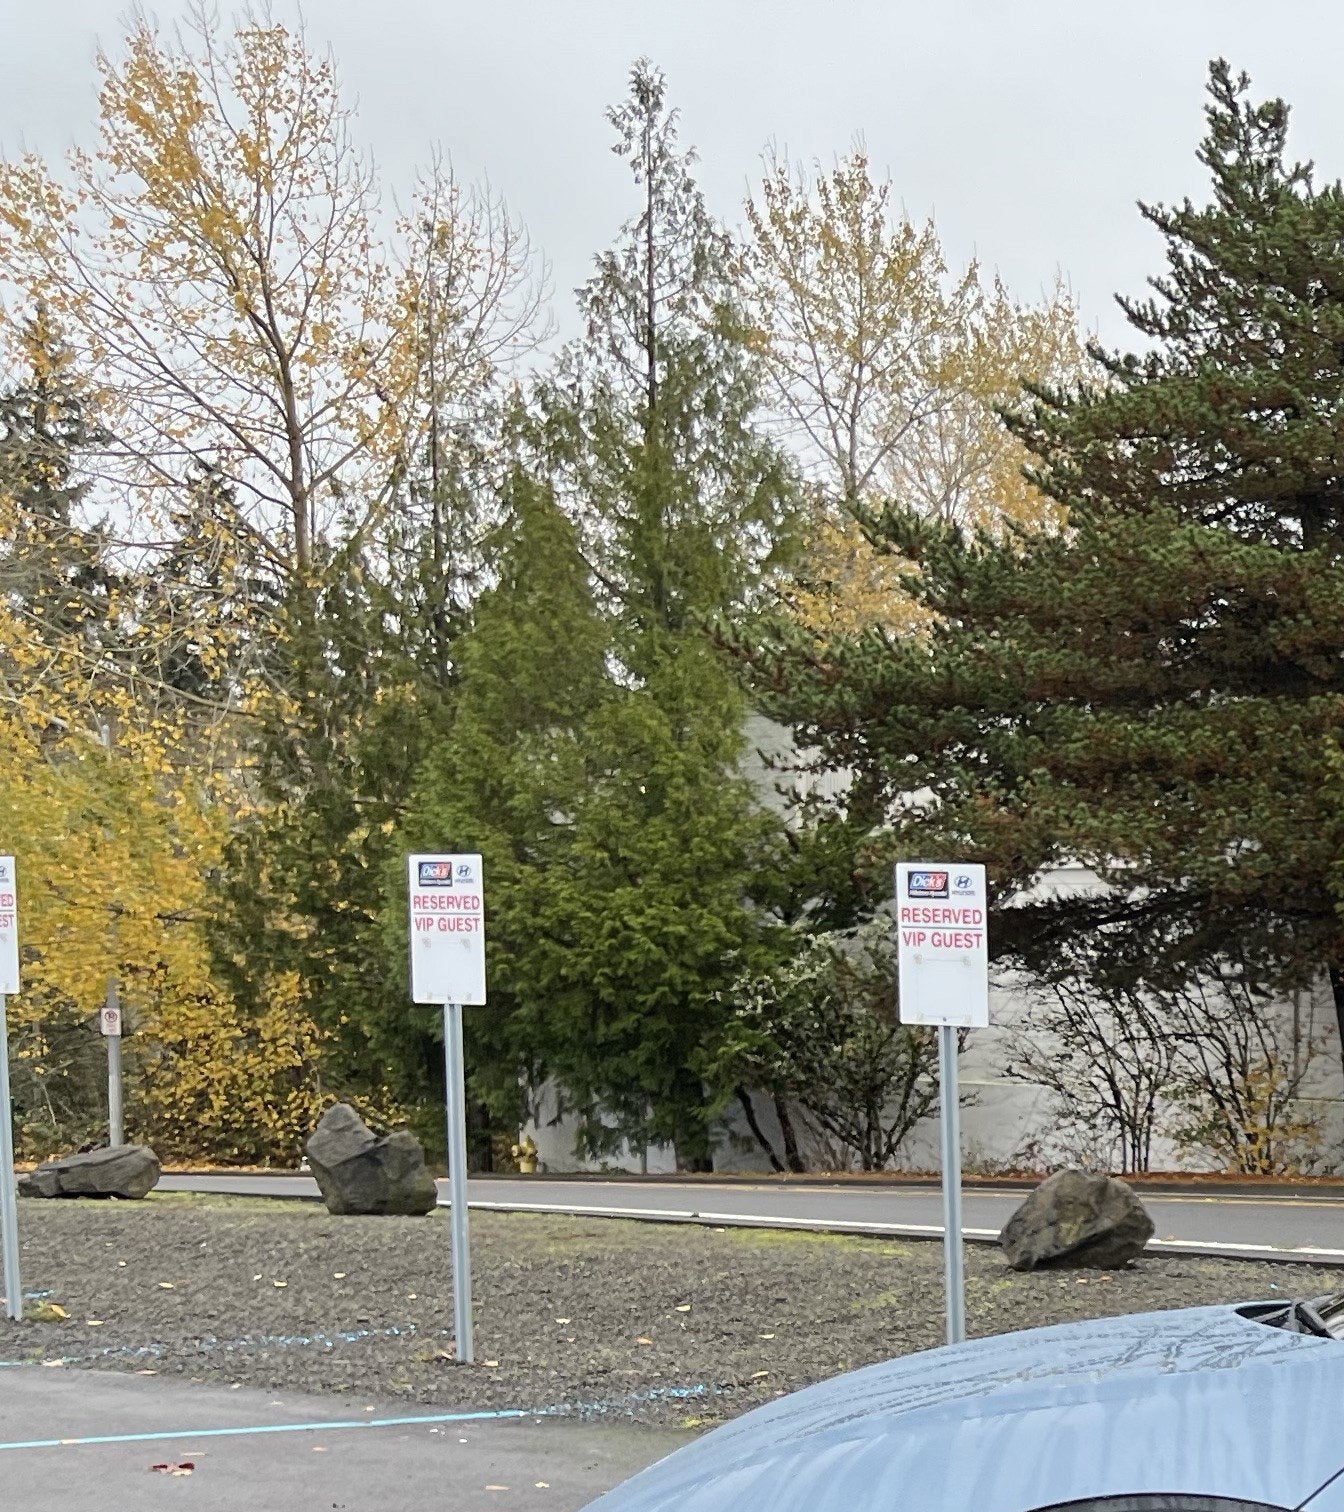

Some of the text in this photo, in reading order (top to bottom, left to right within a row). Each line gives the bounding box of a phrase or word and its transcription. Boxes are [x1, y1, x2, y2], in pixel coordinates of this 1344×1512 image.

[413, 895, 480, 910] RESERVED
[901, 907, 982, 925] RESERVED
[415, 917, 480, 932] VIP GUEST
[903, 931, 983, 948] VIP GUEST
